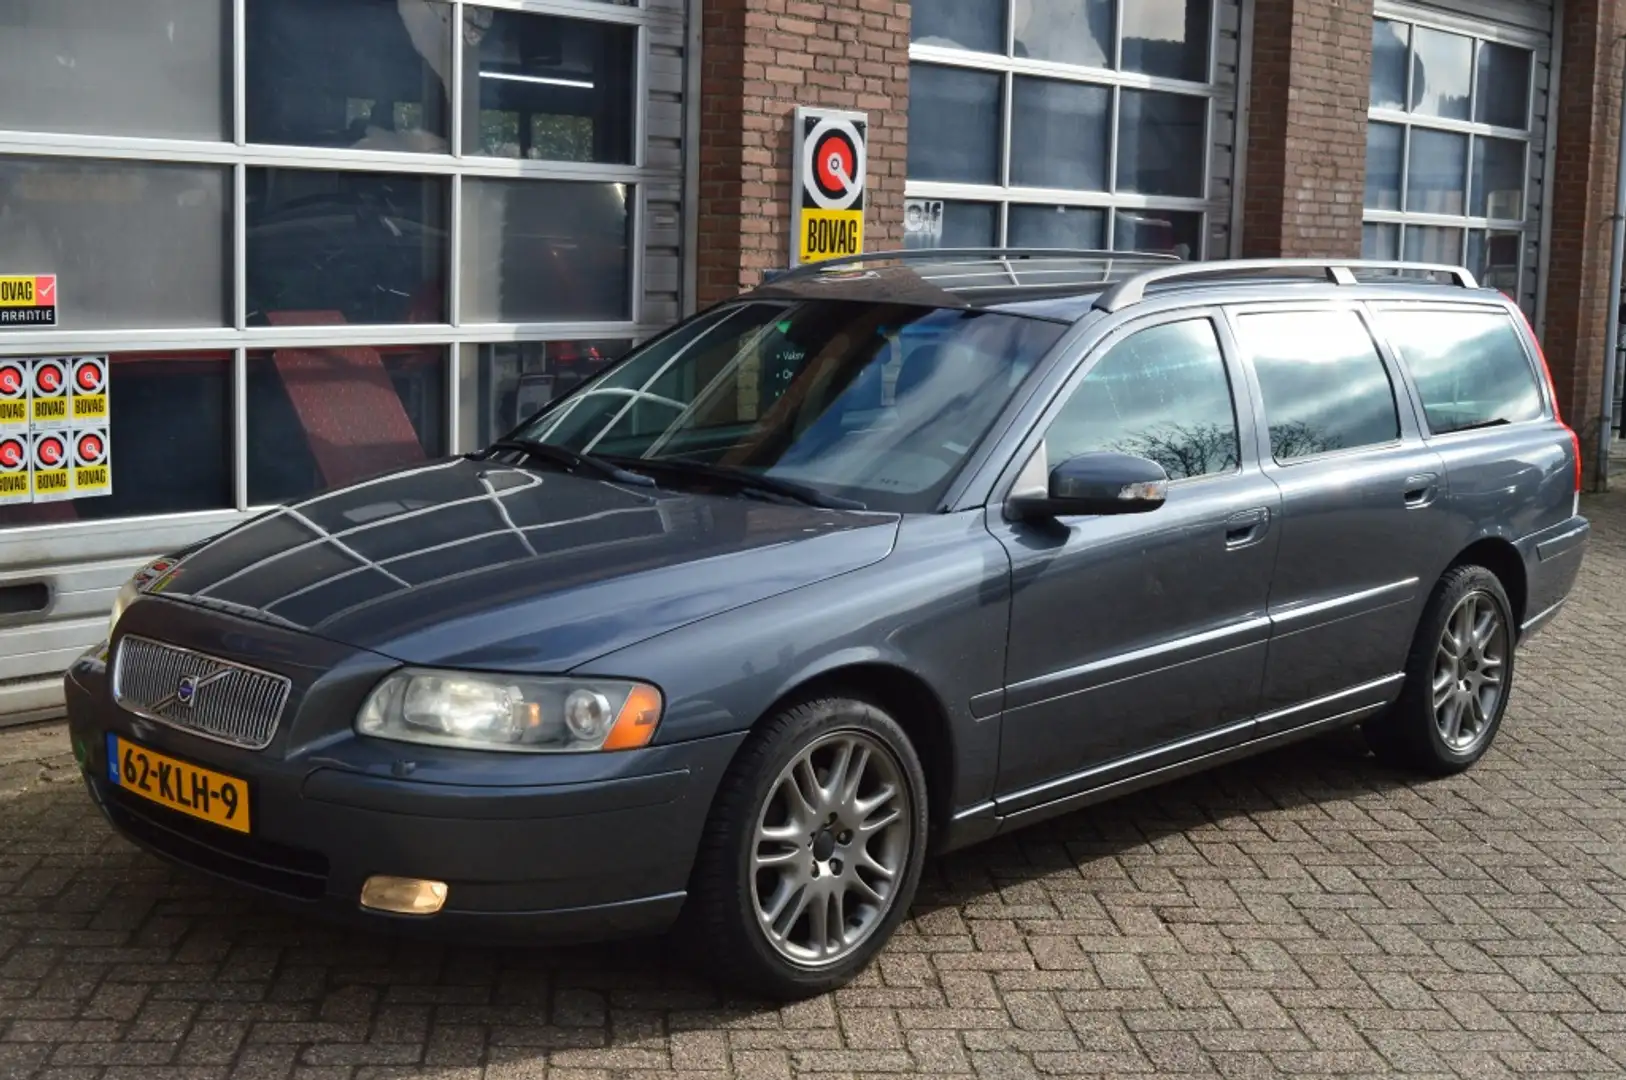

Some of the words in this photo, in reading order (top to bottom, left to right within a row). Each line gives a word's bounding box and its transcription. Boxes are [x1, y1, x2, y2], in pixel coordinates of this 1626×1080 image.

[808, 218, 858, 254] BOVAG
[35, 401, 65, 417] BOVAG
[74, 398, 104, 415] BOVAG
[37, 472, 67, 489] BOVAG
[77, 469, 106, 486] BOVAG
[124, 749, 238, 819] 62-KLH-9
